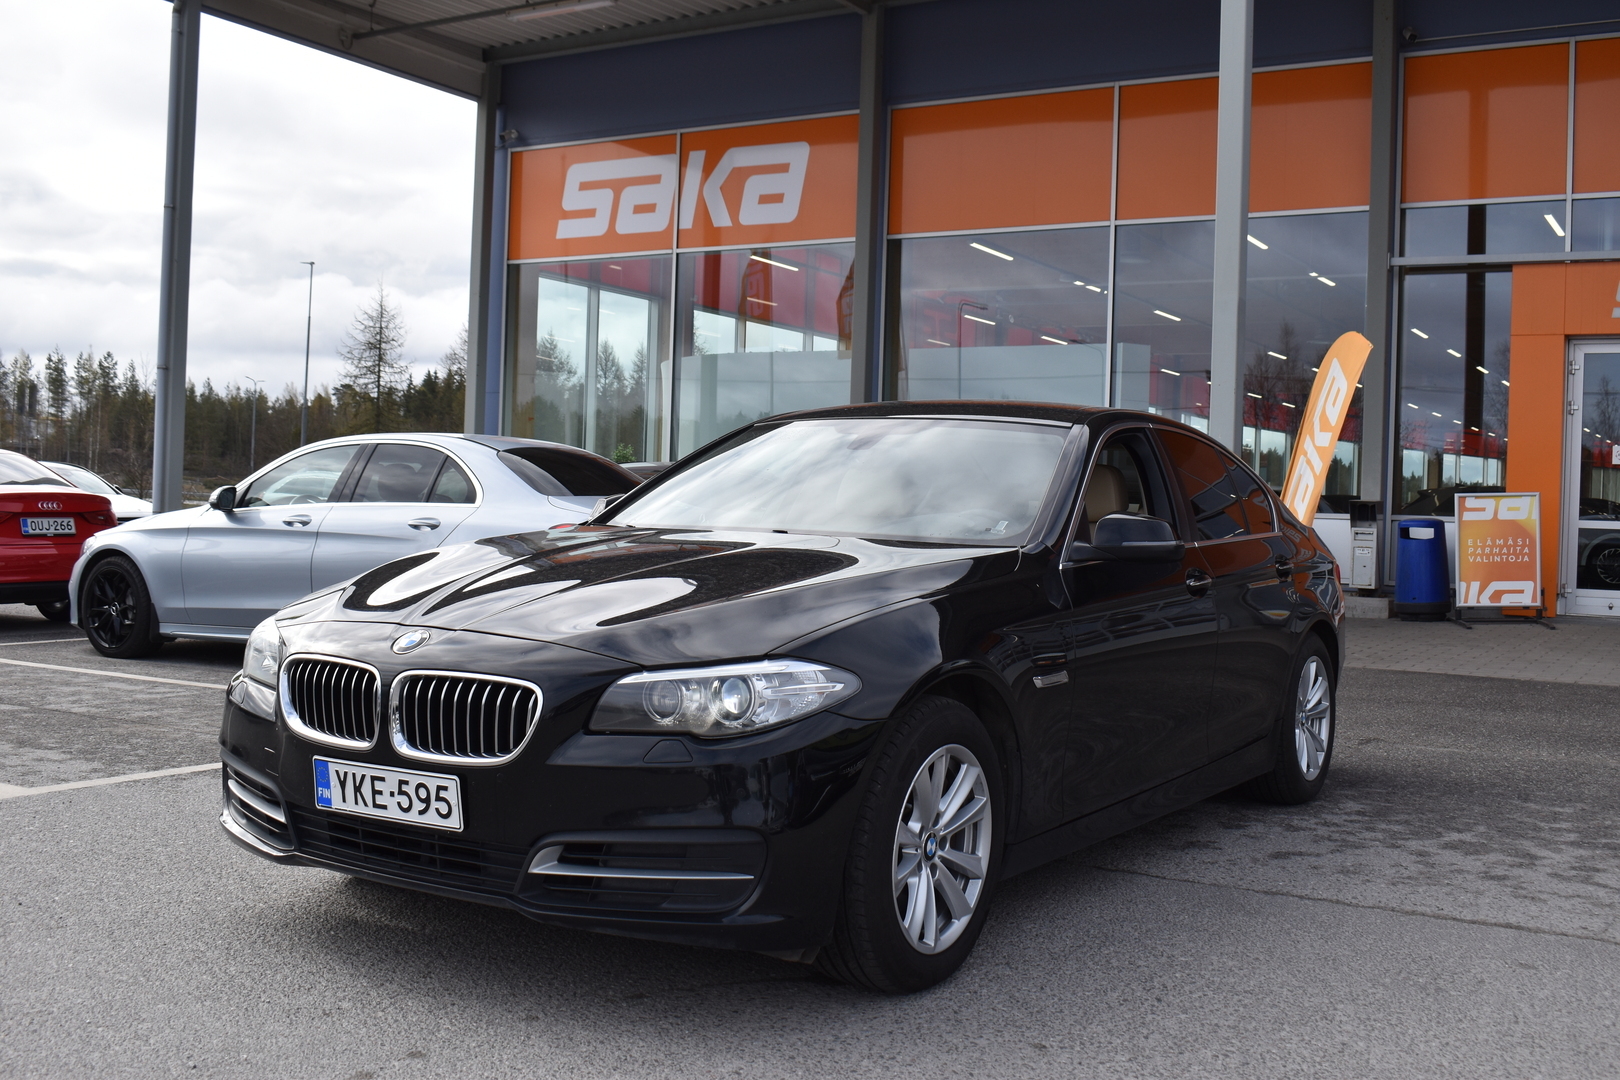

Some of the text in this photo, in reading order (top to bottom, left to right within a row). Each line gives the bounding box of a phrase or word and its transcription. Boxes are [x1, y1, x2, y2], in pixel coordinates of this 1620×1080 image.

[30, 520, 73, 531] OUJ-266
[1468, 537, 1529, 546] ELÄMÄSI
[318, 787, 331, 799] FIN
[334, 769, 453, 819] YKE-595
